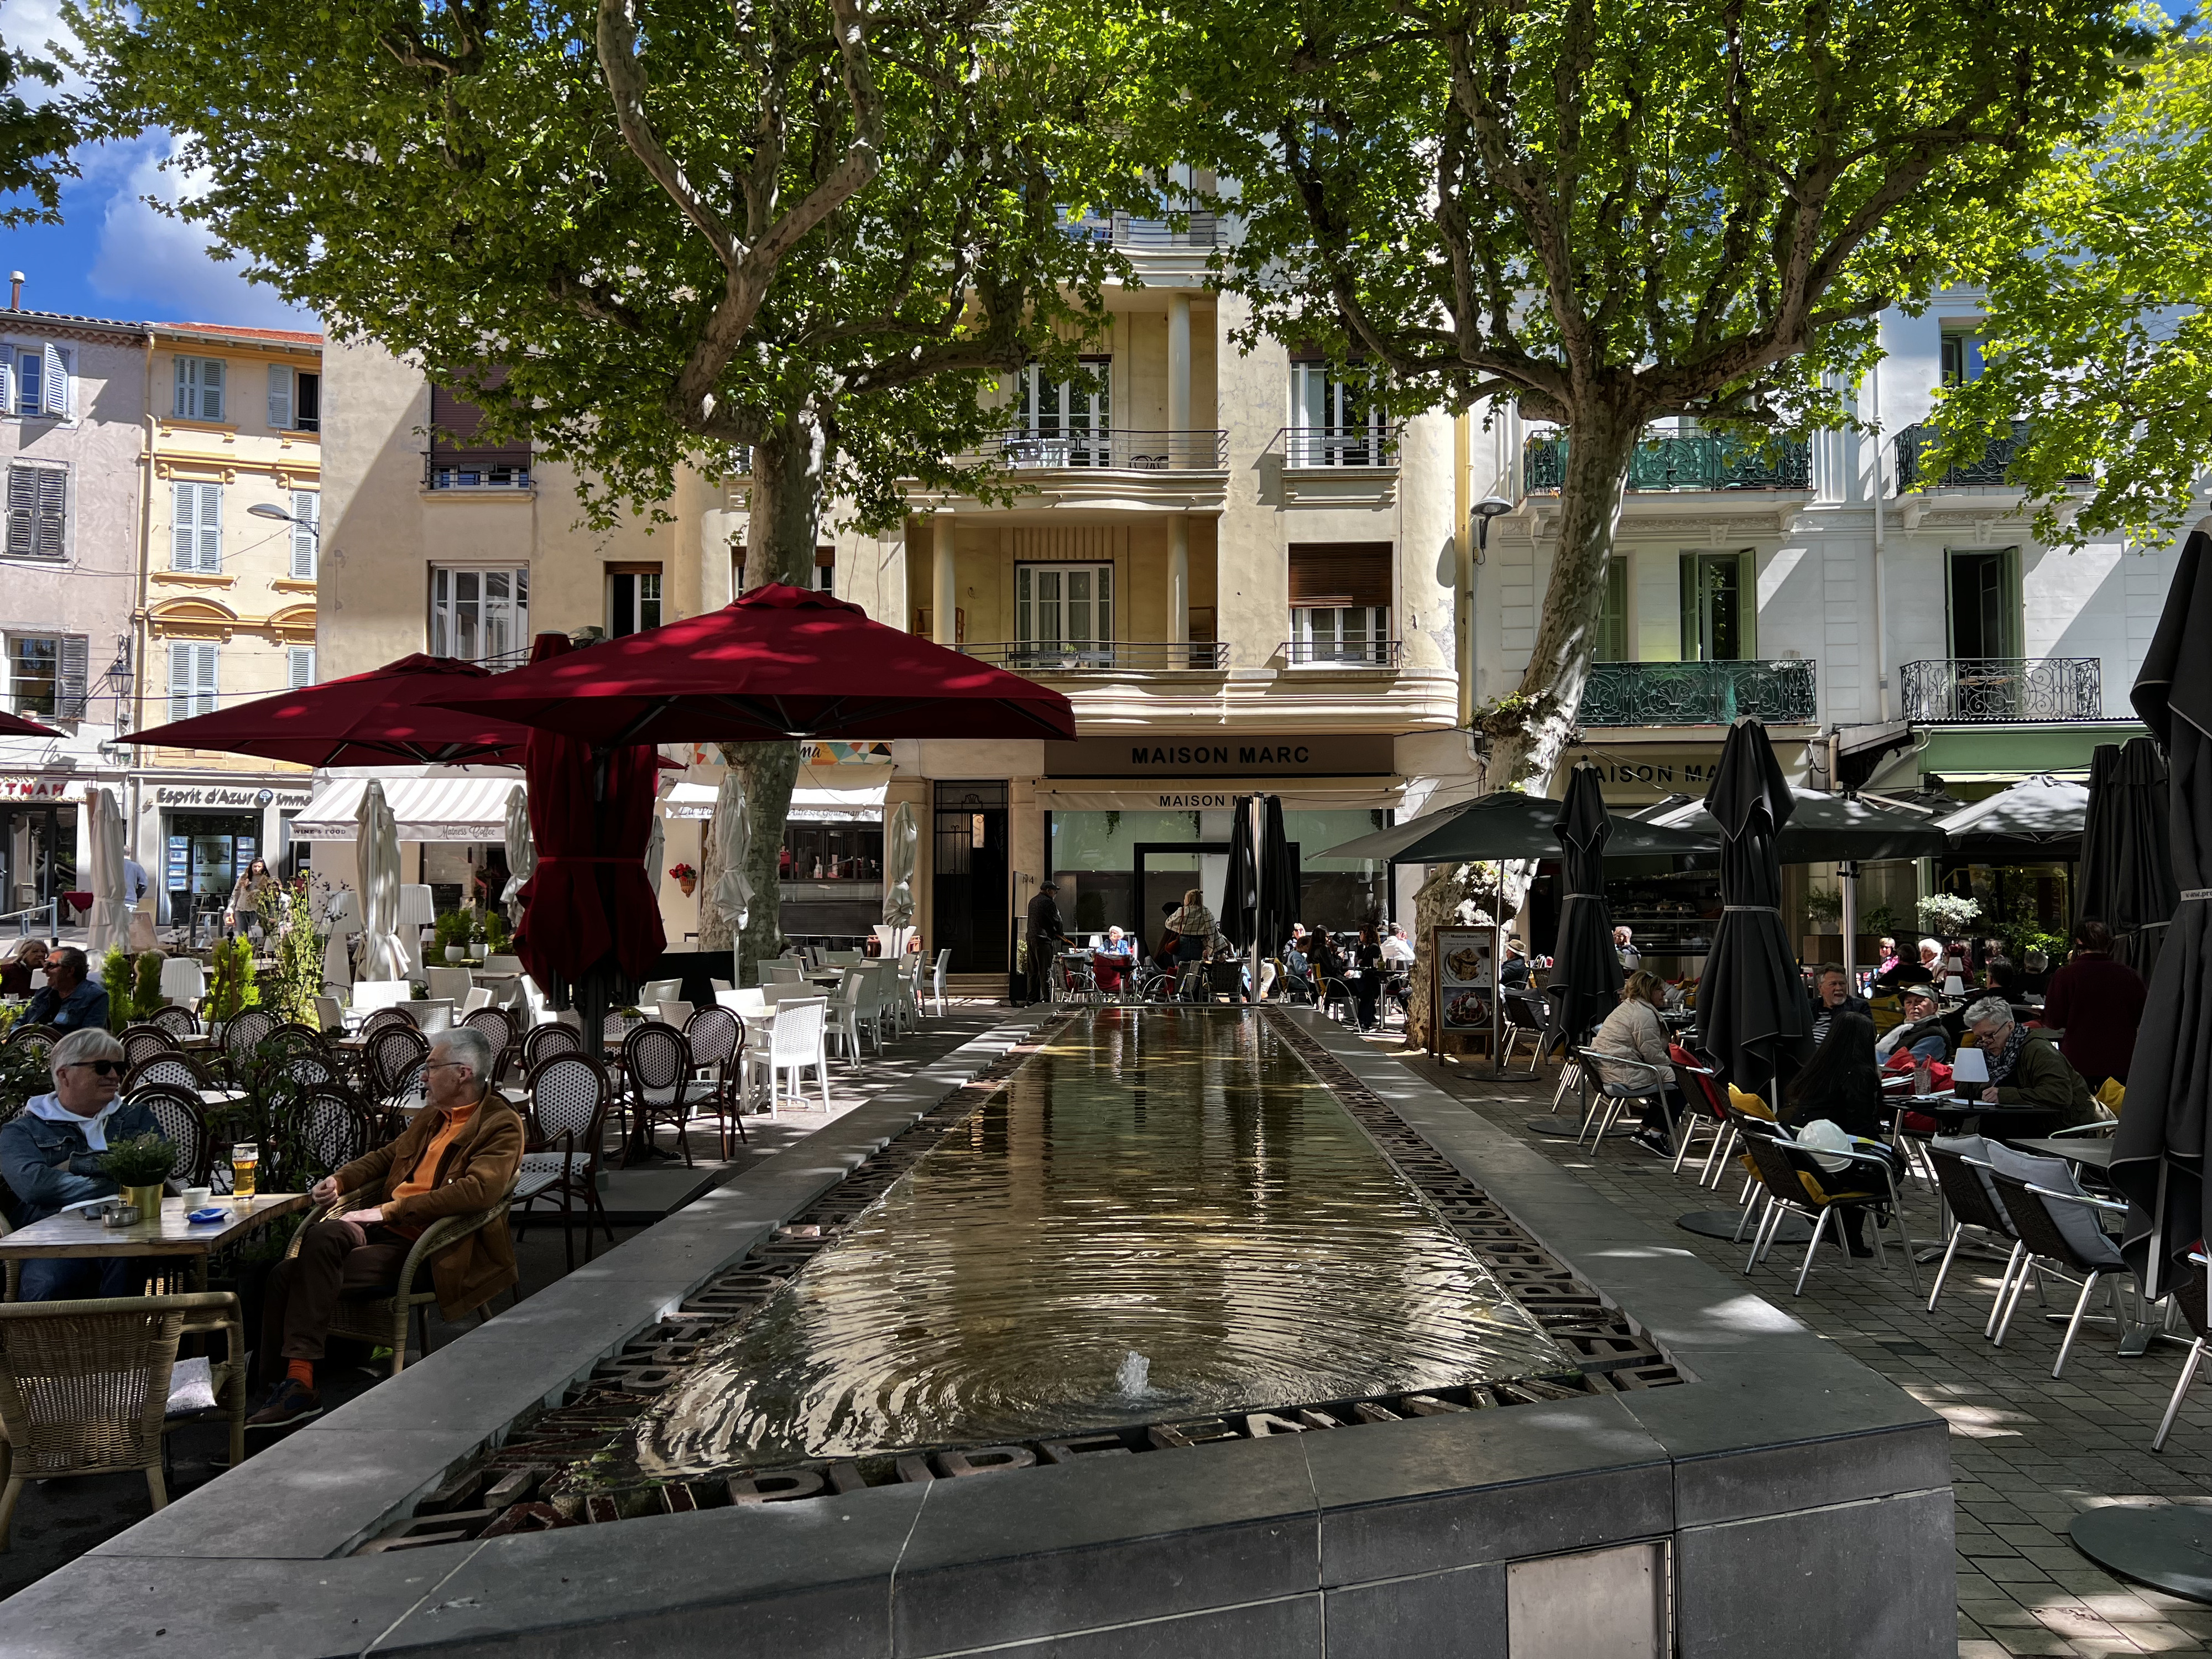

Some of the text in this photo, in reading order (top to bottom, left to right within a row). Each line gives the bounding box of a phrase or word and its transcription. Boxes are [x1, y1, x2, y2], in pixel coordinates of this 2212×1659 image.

[1132, 747, 1309, 764] MAISON MARC
[1571, 765, 1716, 783] AISON MA
[156, 787, 202, 807] Esprit
[205, 788, 254, 805] d'Azur
[1160, 795, 1225, 807] MAISON
[679, 806, 695, 816] La
[822, 808, 869, 818] Gourmande
[469, 825, 495, 838] Coffee
[1377, 1139, 1458, 1175] CLAIRE
[1407, 1172, 1486, 1201] EAU
[1432, 1199, 1597, 1305] PRECIEUSE
[1524, 1298, 1661, 1365] EAU
[414, 1260, 805, 1515] SOUTERRAINE
